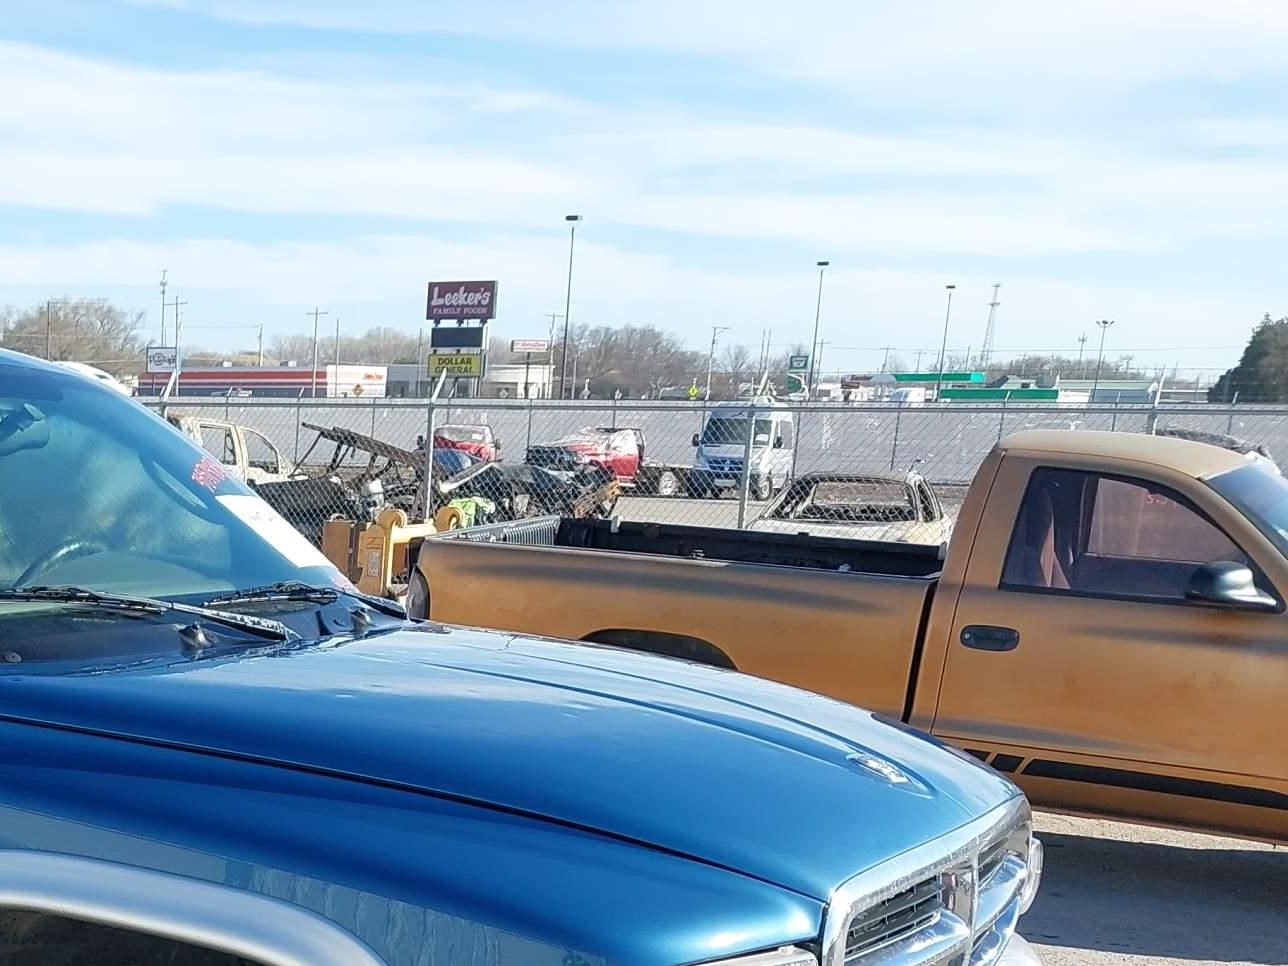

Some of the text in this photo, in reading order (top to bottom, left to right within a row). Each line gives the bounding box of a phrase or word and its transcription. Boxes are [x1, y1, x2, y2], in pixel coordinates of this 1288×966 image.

[430, 286, 491, 306] Leeker's
[432, 307, 461, 315] FAMILY
[437, 357, 472, 366] DOLLAR
